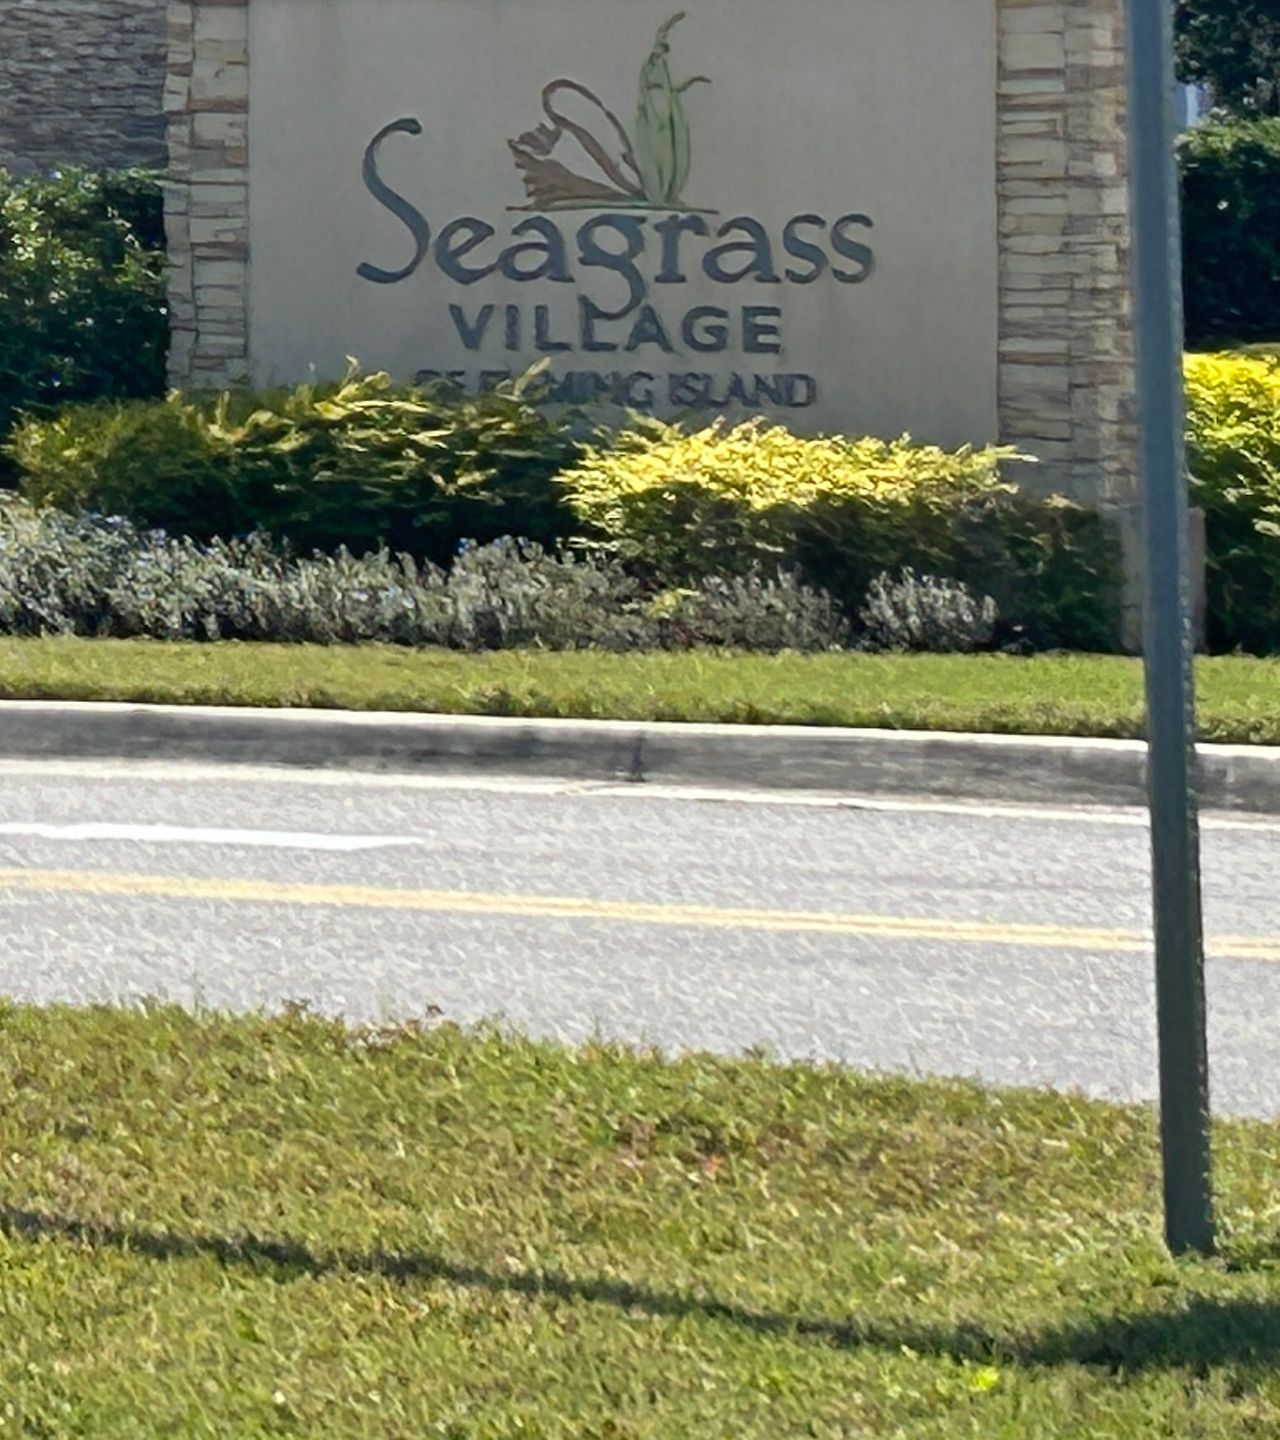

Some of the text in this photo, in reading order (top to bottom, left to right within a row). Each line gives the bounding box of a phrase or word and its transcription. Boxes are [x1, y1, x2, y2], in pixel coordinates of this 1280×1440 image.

[356, 117, 876, 320] Seagrass
[448, 303, 783, 354] VILLAGE
[668, 371, 817, 409] ISLAND
